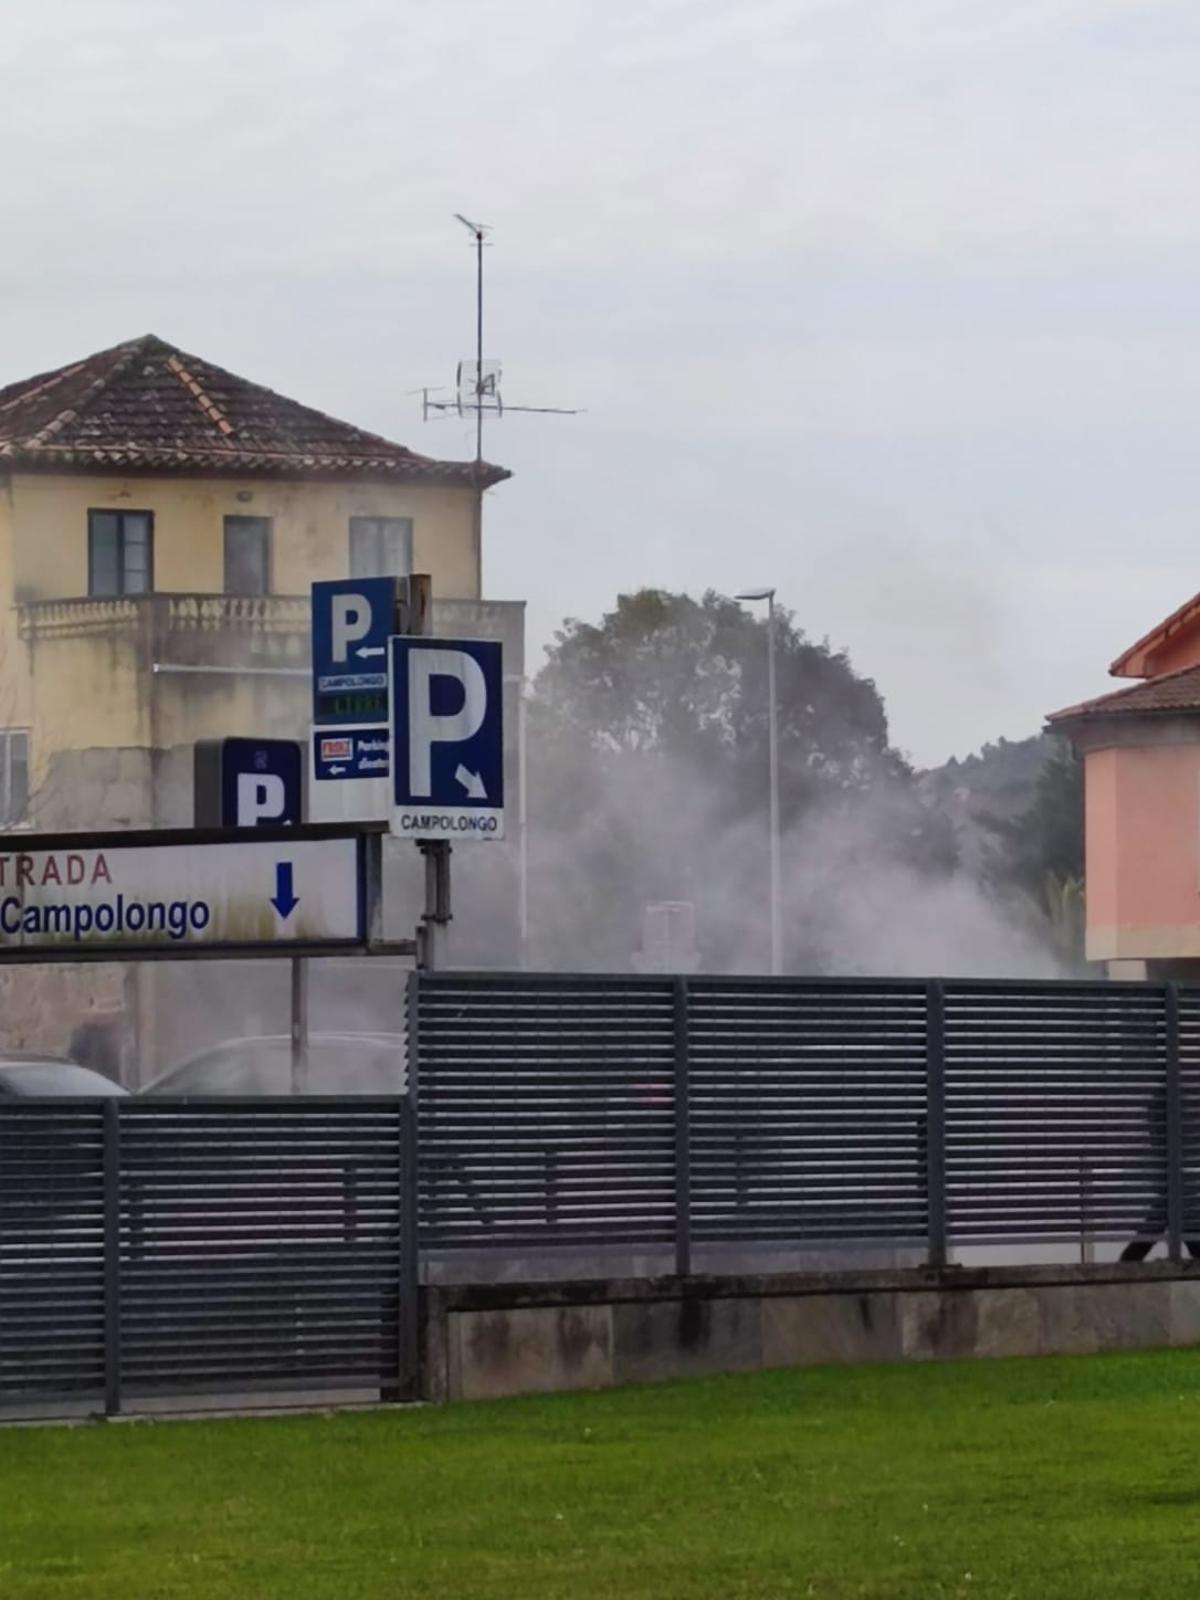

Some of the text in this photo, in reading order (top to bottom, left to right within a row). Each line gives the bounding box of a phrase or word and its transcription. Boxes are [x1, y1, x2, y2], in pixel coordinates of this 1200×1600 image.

[332, 594, 372, 663] P
[408, 649, 487, 797] P
[237, 773, 285, 826] P
[401, 815, 497, 833] CAMPOLONGO
[1, 894, 209, 941] Campolongo
